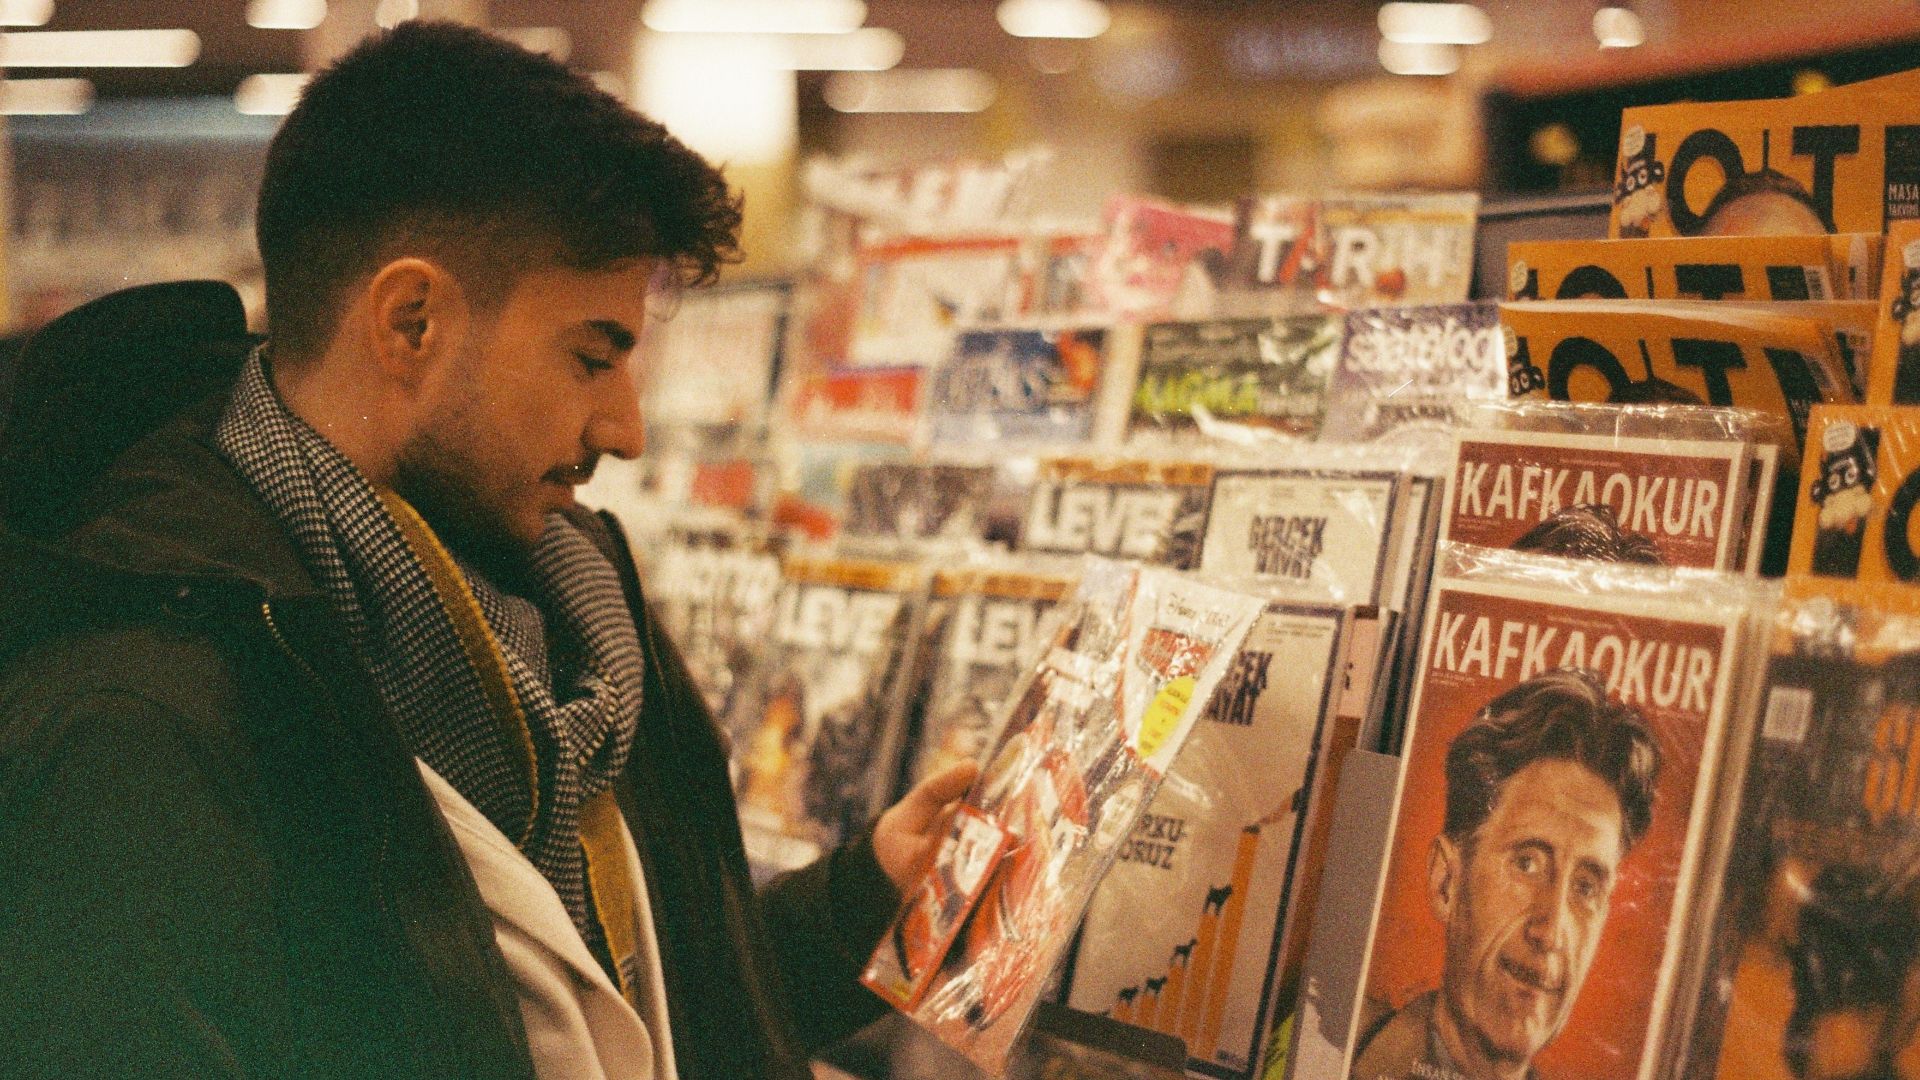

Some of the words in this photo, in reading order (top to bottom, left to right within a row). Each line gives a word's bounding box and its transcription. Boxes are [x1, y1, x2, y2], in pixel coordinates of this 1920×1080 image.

[1459, 460, 1719, 539] KAFKAOKUR
[1433, 611, 1713, 712] KAFKAOKUR
[1119, 838, 1175, 870] ORUZ
